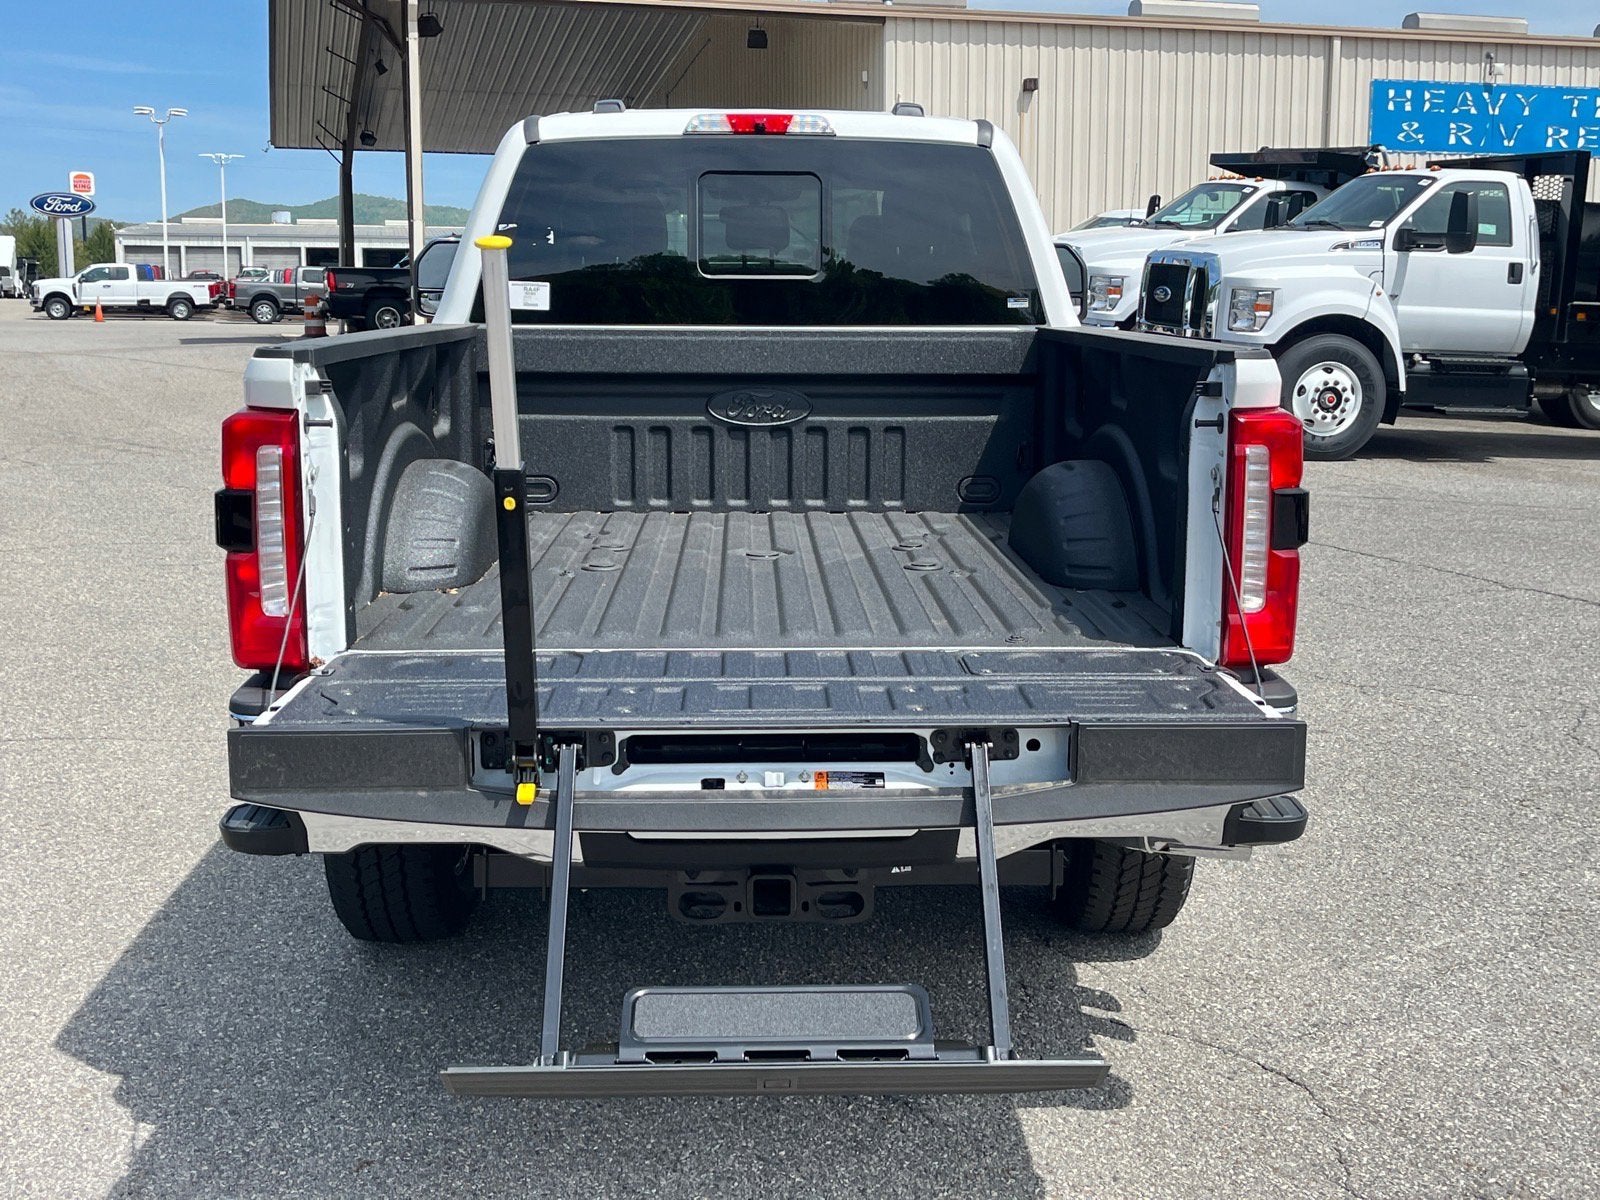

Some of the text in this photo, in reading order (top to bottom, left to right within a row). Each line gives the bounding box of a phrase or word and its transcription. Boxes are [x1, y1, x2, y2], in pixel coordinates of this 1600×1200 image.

[1387, 88, 1538, 116] HEAVY
[1397, 121, 1424, 144] &
[1545, 126, 1600, 149] RE
[43, 196, 82, 212] Ford
[726, 391, 791, 418] Ford
